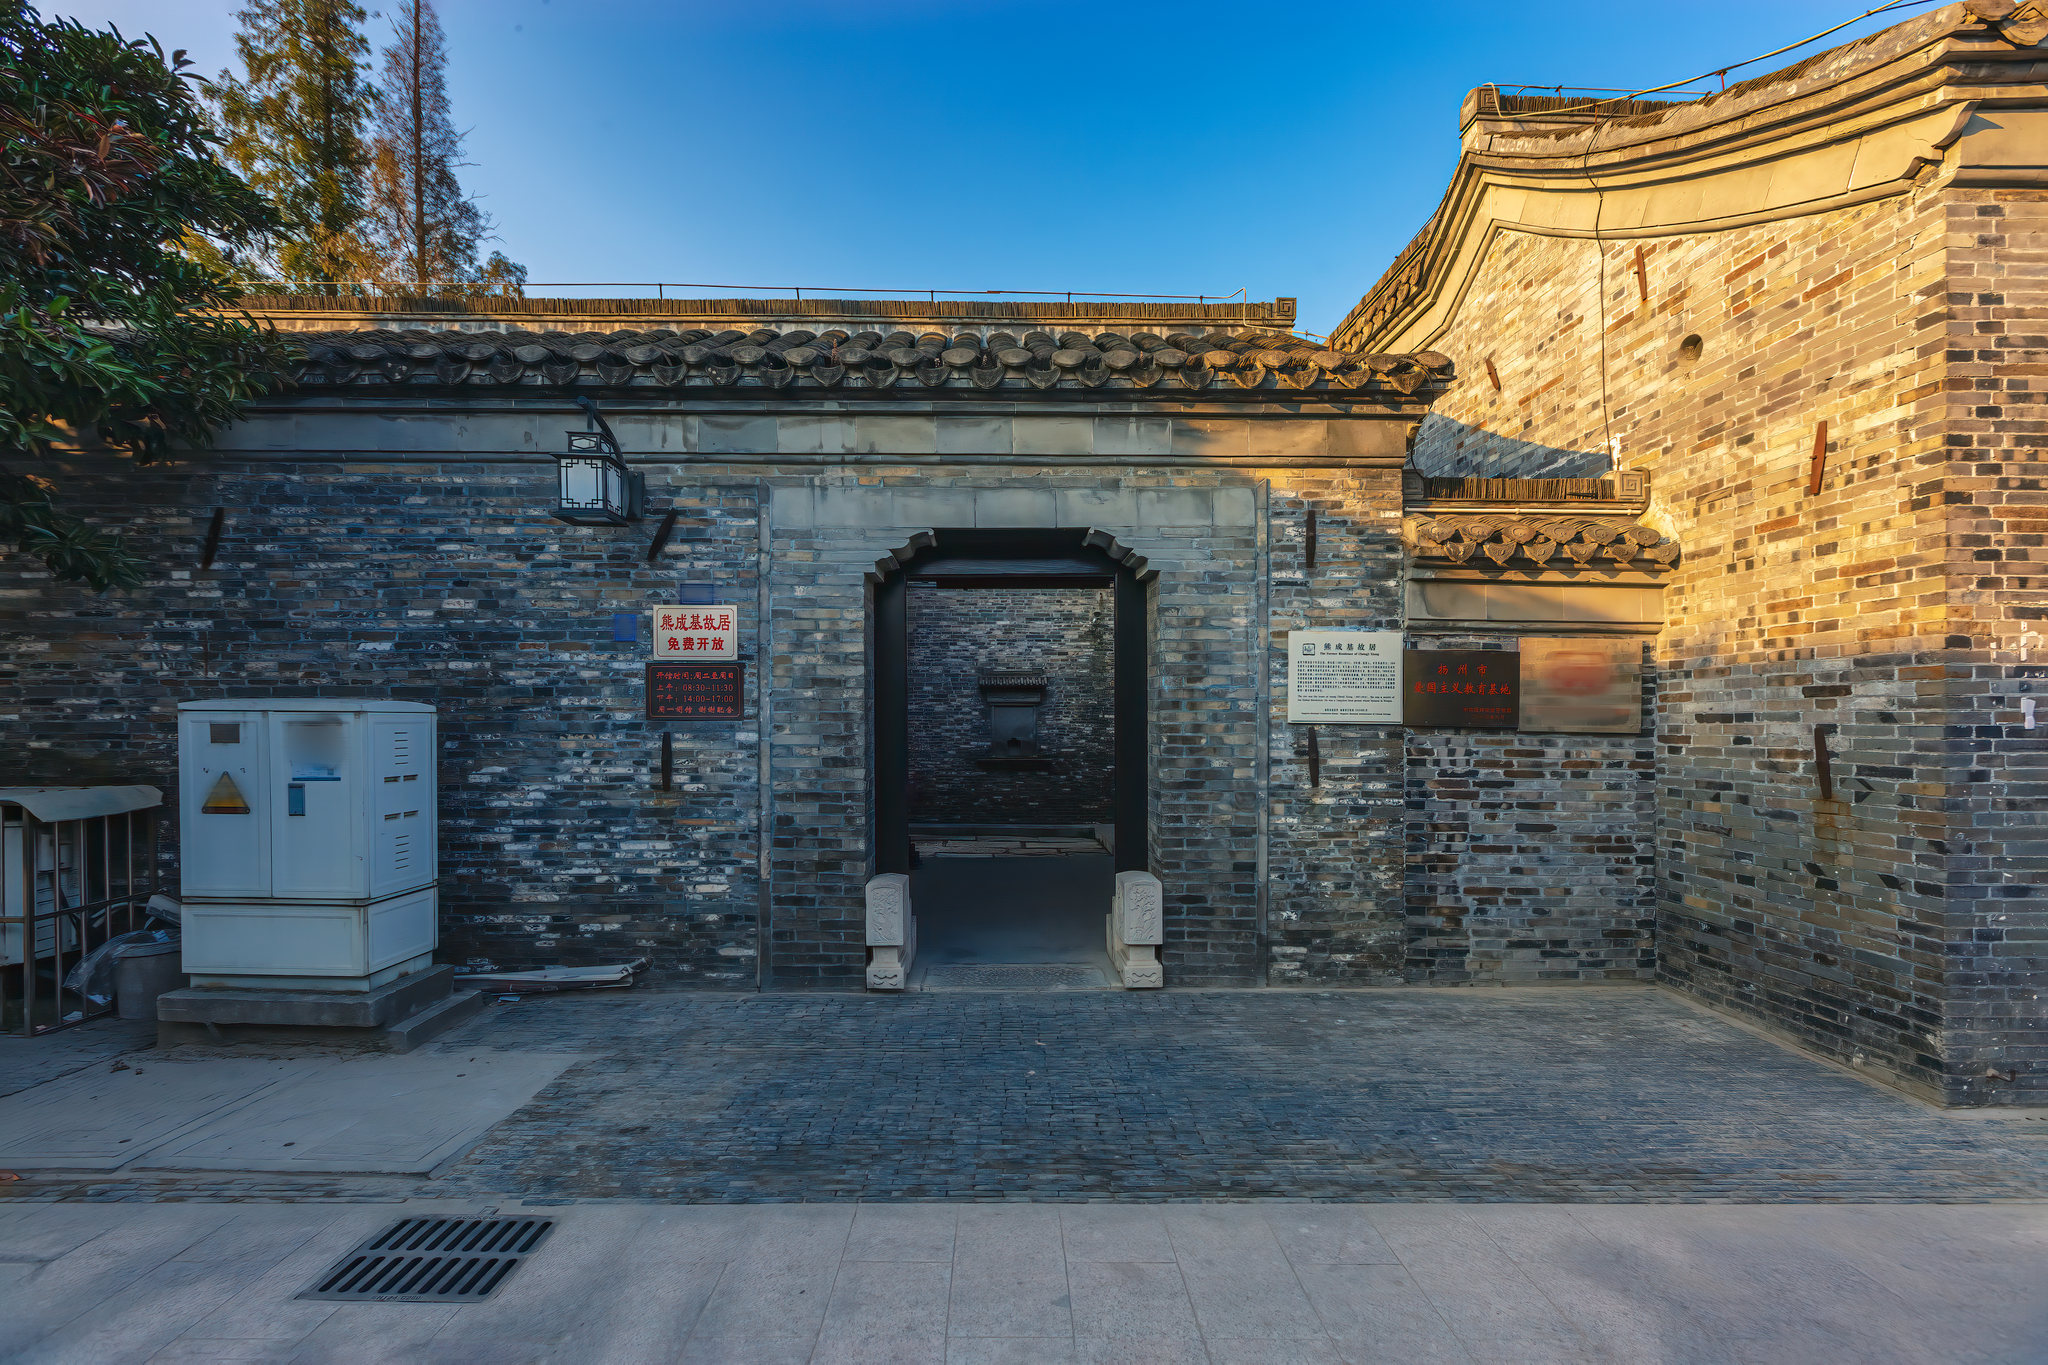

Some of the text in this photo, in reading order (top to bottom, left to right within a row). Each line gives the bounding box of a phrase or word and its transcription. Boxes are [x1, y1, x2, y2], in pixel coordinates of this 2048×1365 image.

[660, 614, 731, 631] 熊成基故居
[667, 636, 725, 651] 免费开放
[1323, 642, 1376, 651] 熊成基故居
[1437, 663, 1488, 677] 扬州市
[682, 683, 734, 692] 08:30-11:30
[683, 695, 734, 703] 14:00-17:00
